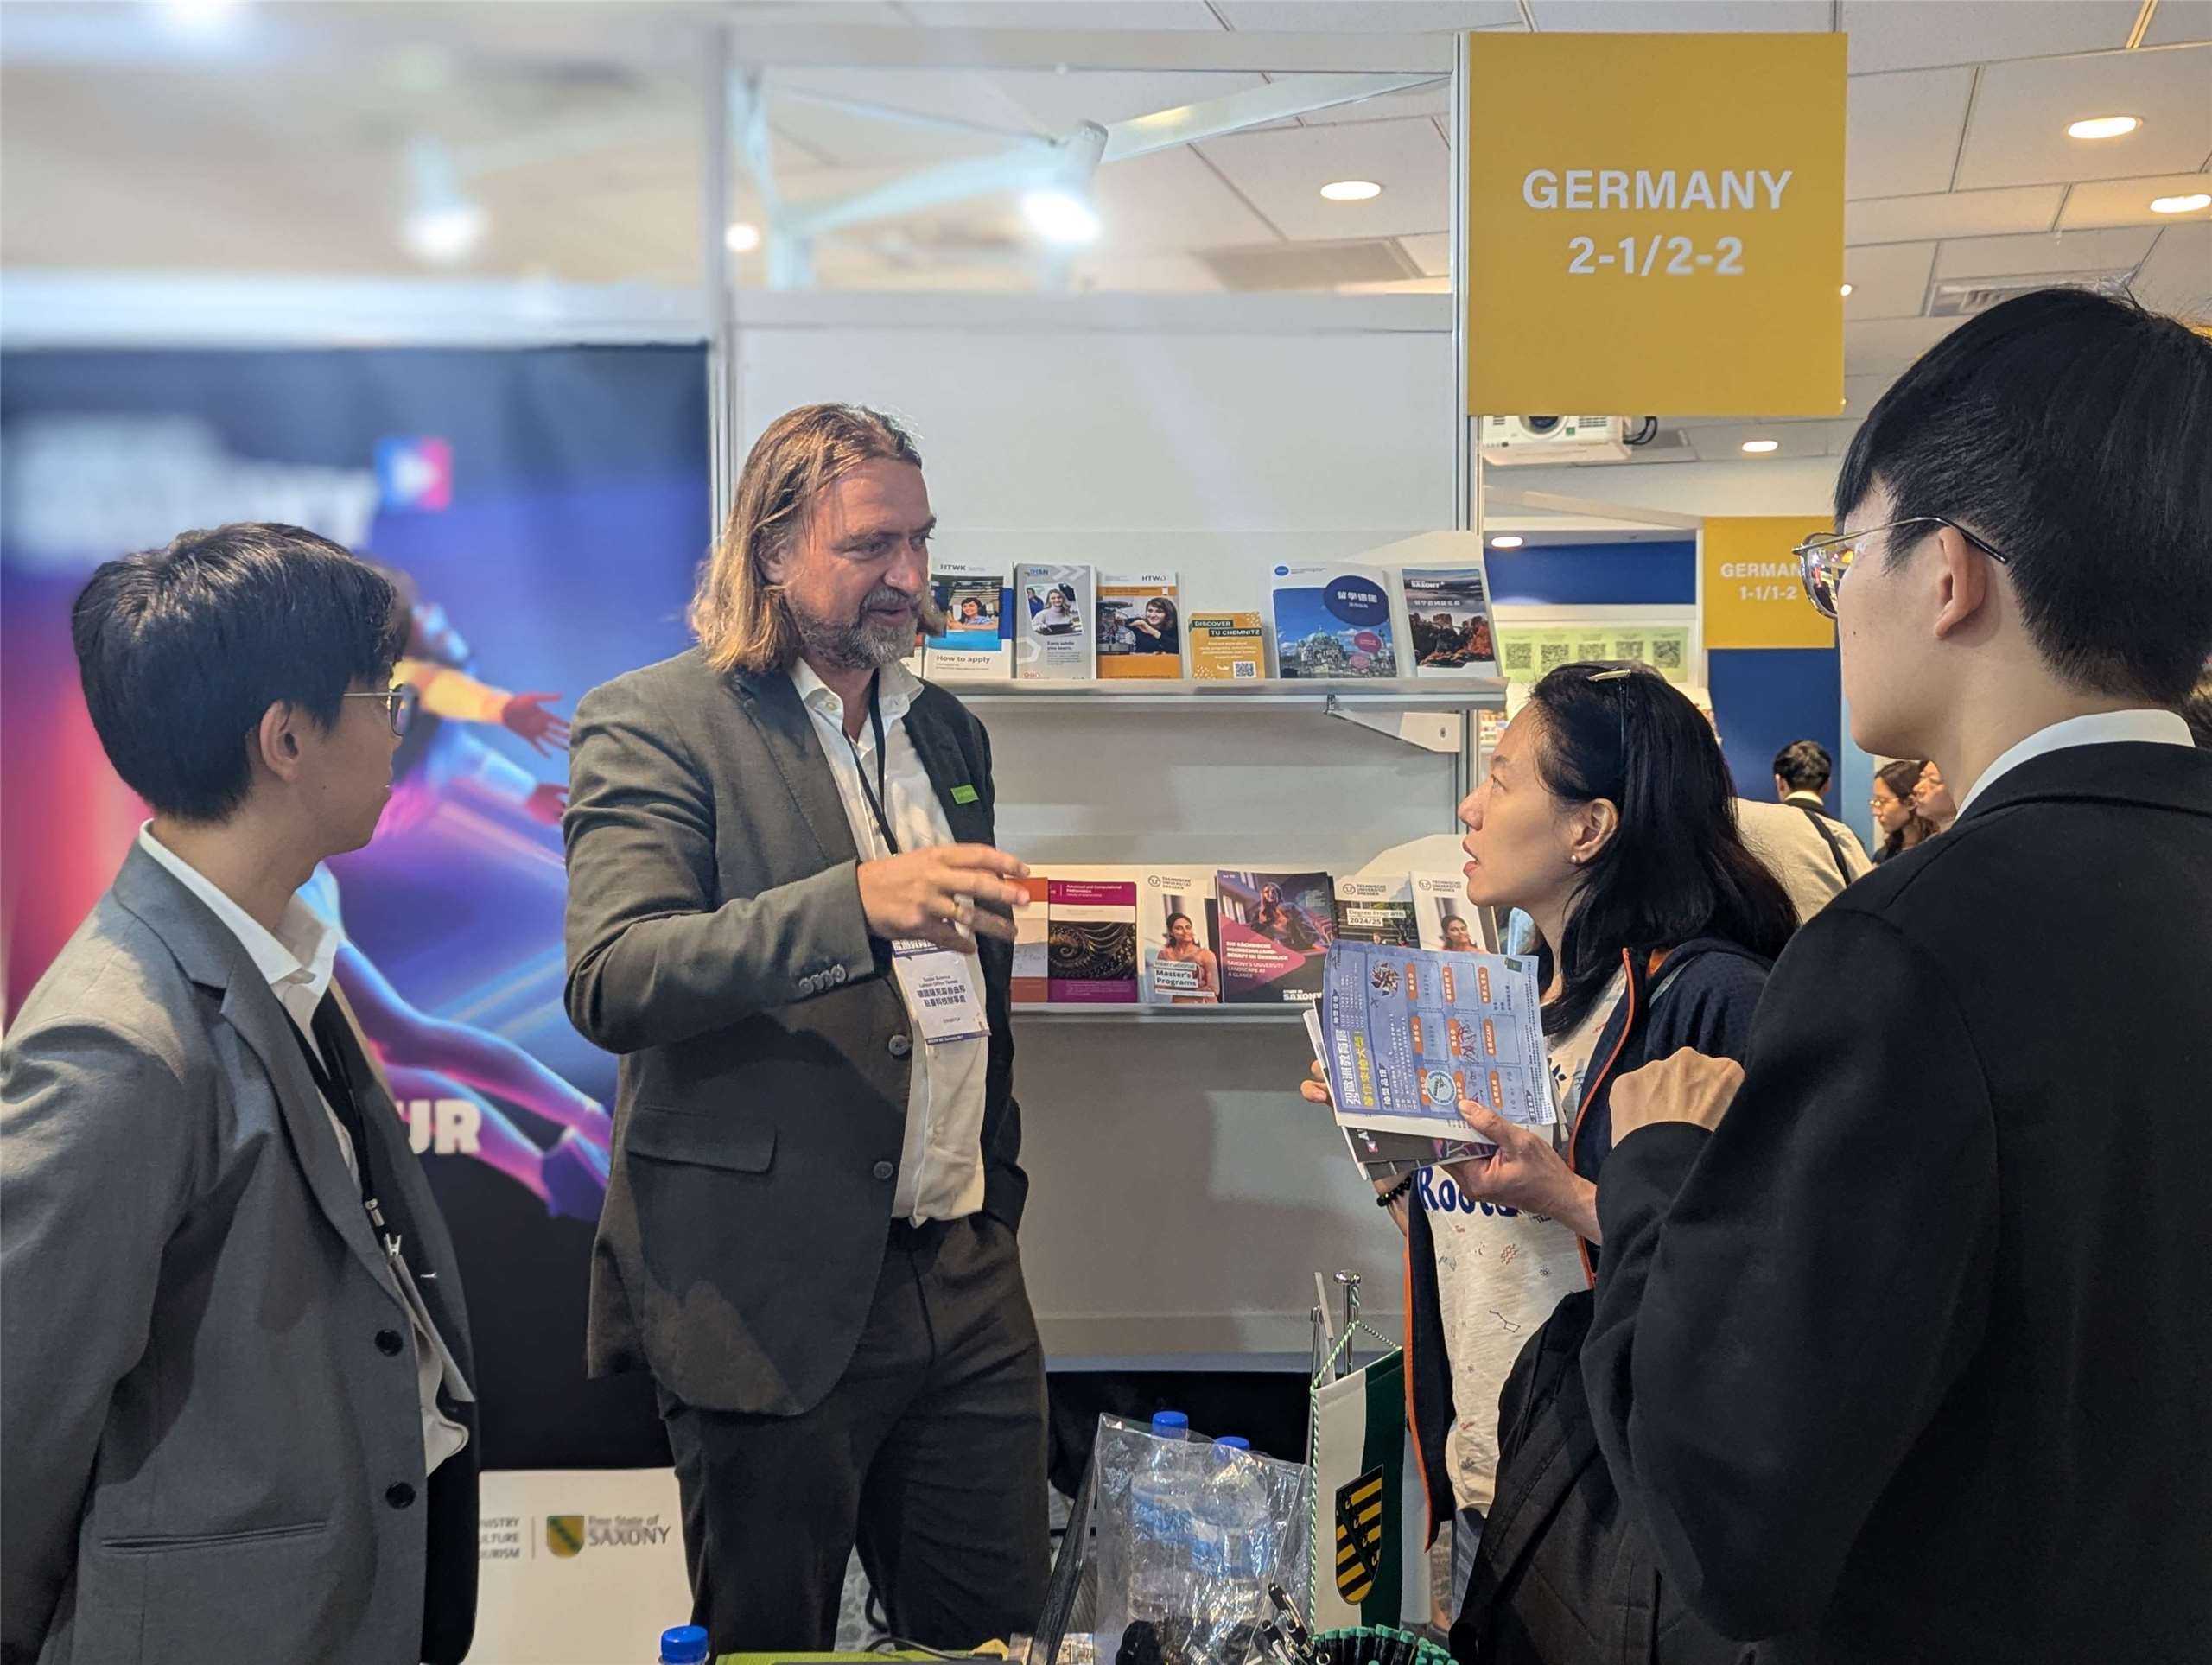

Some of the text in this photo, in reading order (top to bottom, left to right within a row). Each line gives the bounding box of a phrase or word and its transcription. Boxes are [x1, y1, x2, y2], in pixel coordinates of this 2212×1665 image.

[1522, 168, 1794, 210] GERMANY
[1567, 234, 1745, 277] 2-1/2-2
[1719, 562, 1801, 578] GERMAN
[1738, 585, 1798, 601] 1-1/1-2
[967, 656, 991, 664] apply
[1156, 969, 1192, 978] Master's
[1156, 977, 1197, 987] Programs
[1283, 992, 1322, 1001] SAXONY
[588, 1525, 671, 1546] SAXONY
